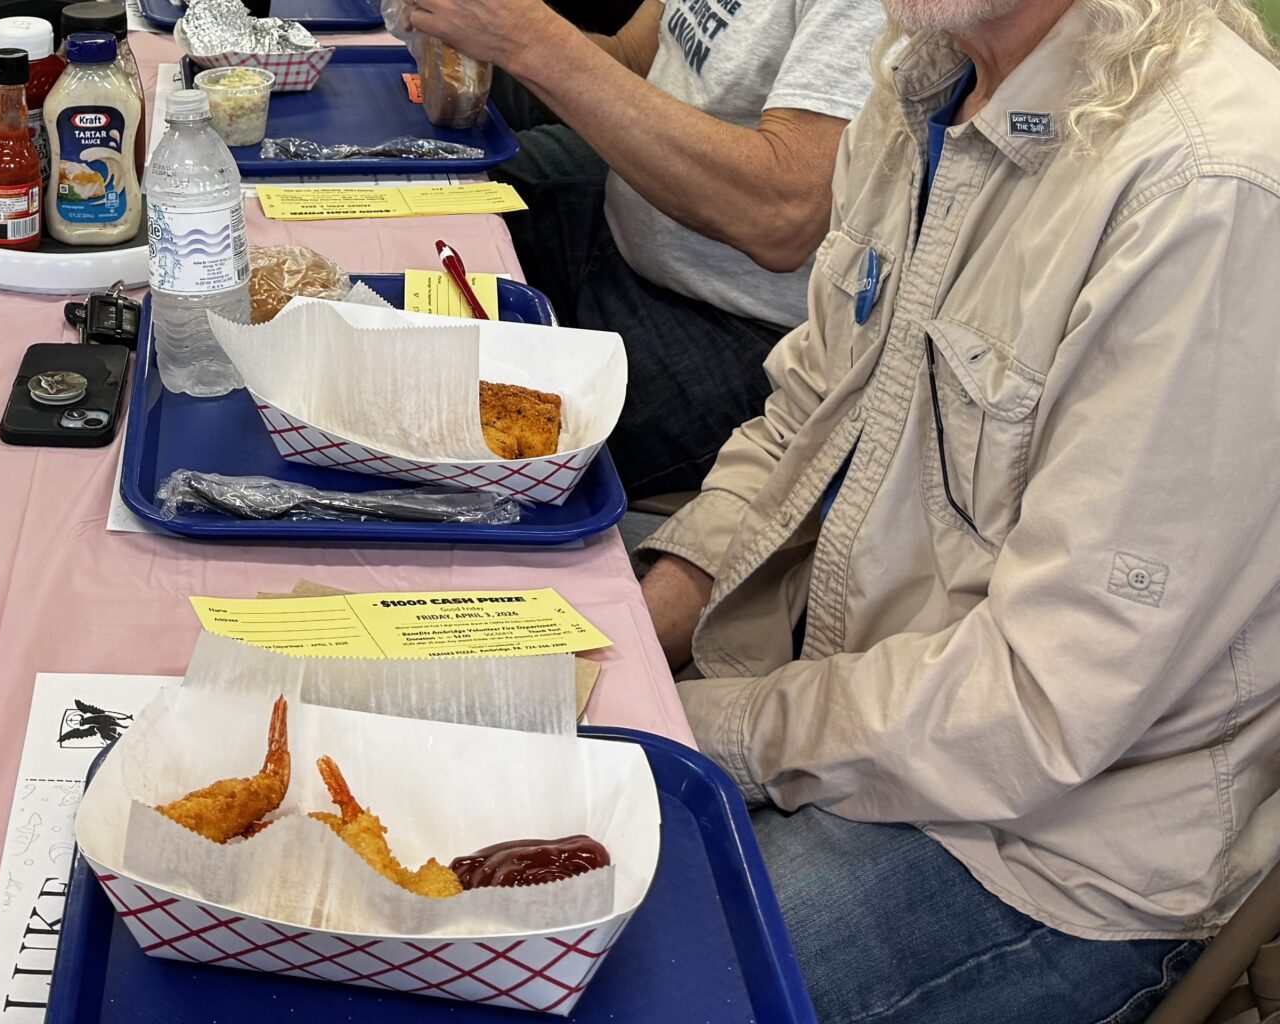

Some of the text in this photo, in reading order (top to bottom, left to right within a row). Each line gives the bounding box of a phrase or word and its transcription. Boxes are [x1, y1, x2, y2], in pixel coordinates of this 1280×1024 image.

[668, 8, 710, 74] UNION
[79, 115, 102, 125] Kraft
[74, 130, 107, 138] TARTAR
[380, 599, 426, 607] $1000
